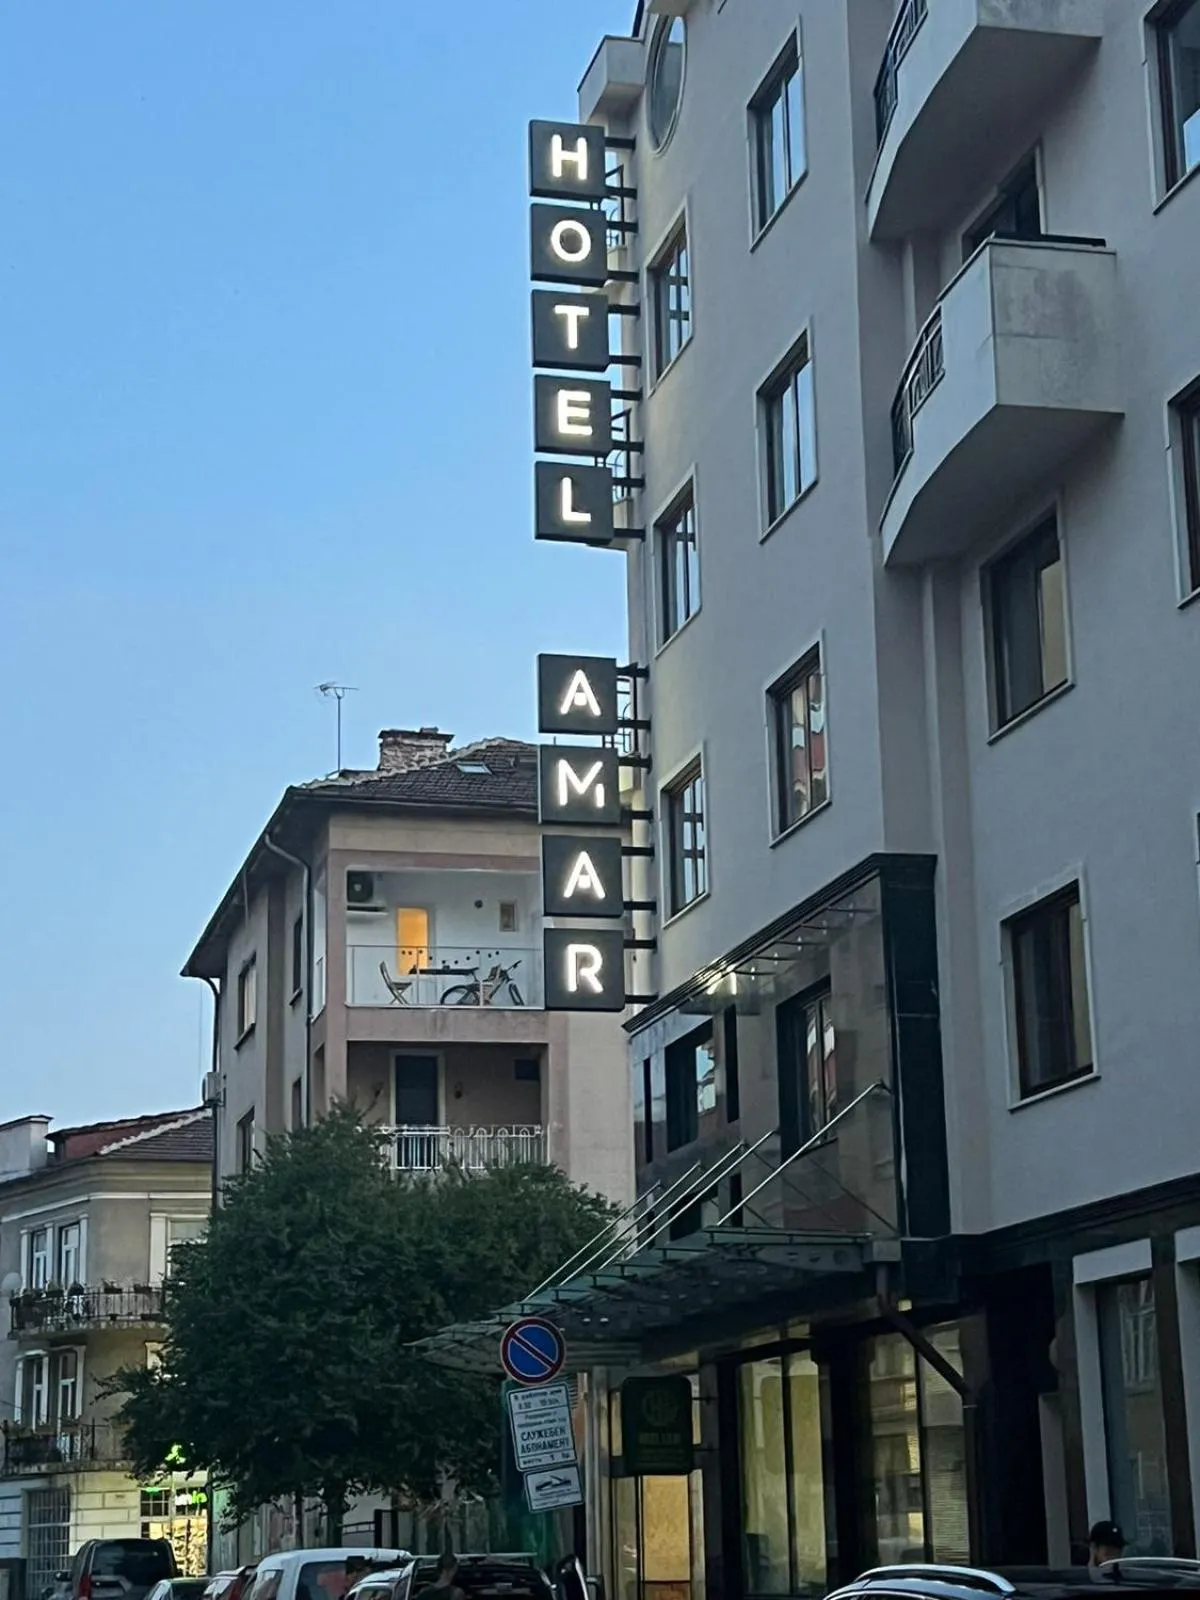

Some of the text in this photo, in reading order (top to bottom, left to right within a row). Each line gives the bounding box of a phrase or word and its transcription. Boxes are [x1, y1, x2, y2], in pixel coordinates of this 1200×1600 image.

[550, 133, 593, 523] HOTEL
[557, 669, 606, 993] AMAR
[520, 1426, 566, 1441] СЛУЖЕБЕН
[521, 1438, 569, 1454] АБОНАМЕНТ
